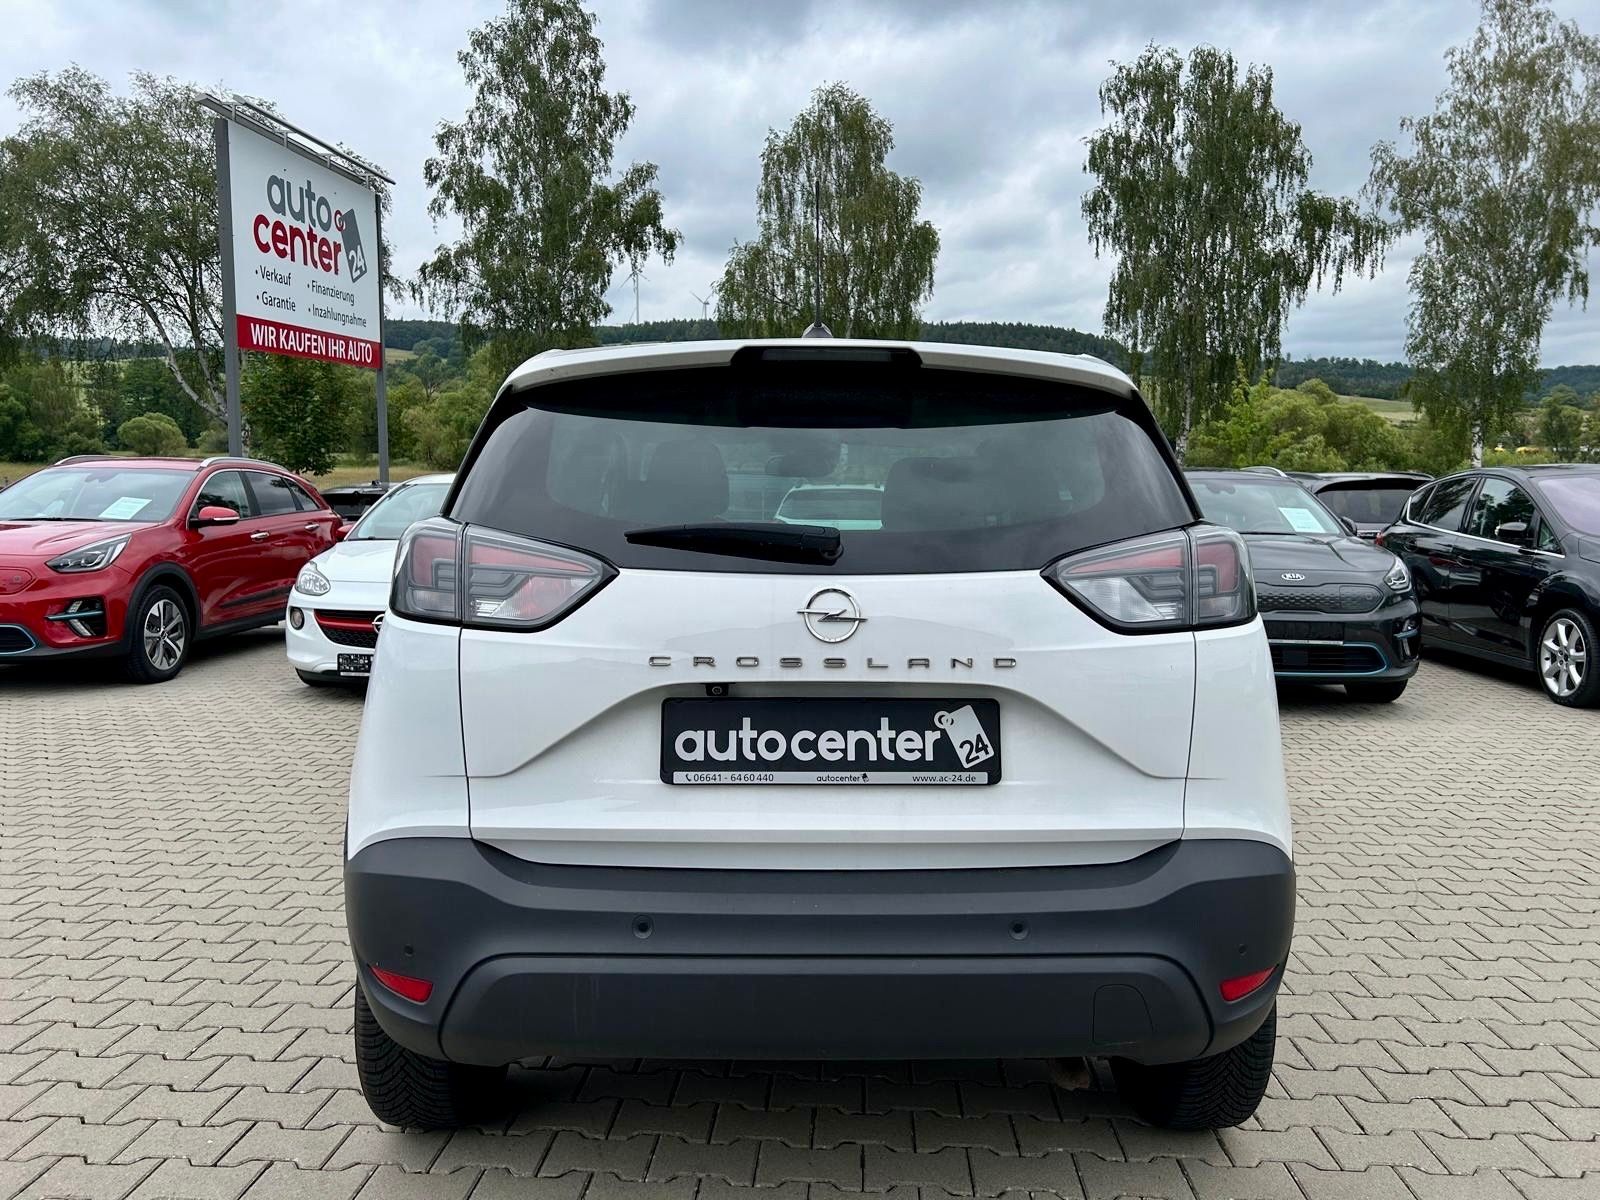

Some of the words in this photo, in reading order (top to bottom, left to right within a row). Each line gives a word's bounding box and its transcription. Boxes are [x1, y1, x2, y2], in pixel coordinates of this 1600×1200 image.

[267, 174, 332, 232] auto
[253, 214, 342, 275] center
[349, 244, 366, 275] 24
[260, 265, 292, 287] Verkauf
[261, 292, 296, 312] Garantie
[311, 280, 355, 305] Finanzierung
[312, 306, 367, 328] Inzahlungnahme
[250, 322, 277, 348] WIR
[279, 329, 326, 356] KAUFEN
[328, 337, 346, 360] IHR
[347, 340, 373, 364] AUTO
[648, 655, 1017, 669] CROSSLAND
[958, 733, 990, 765] 24
[816, 774, 861, 782] autocenter
[912, 774, 977, 783] www.ac-24.de
